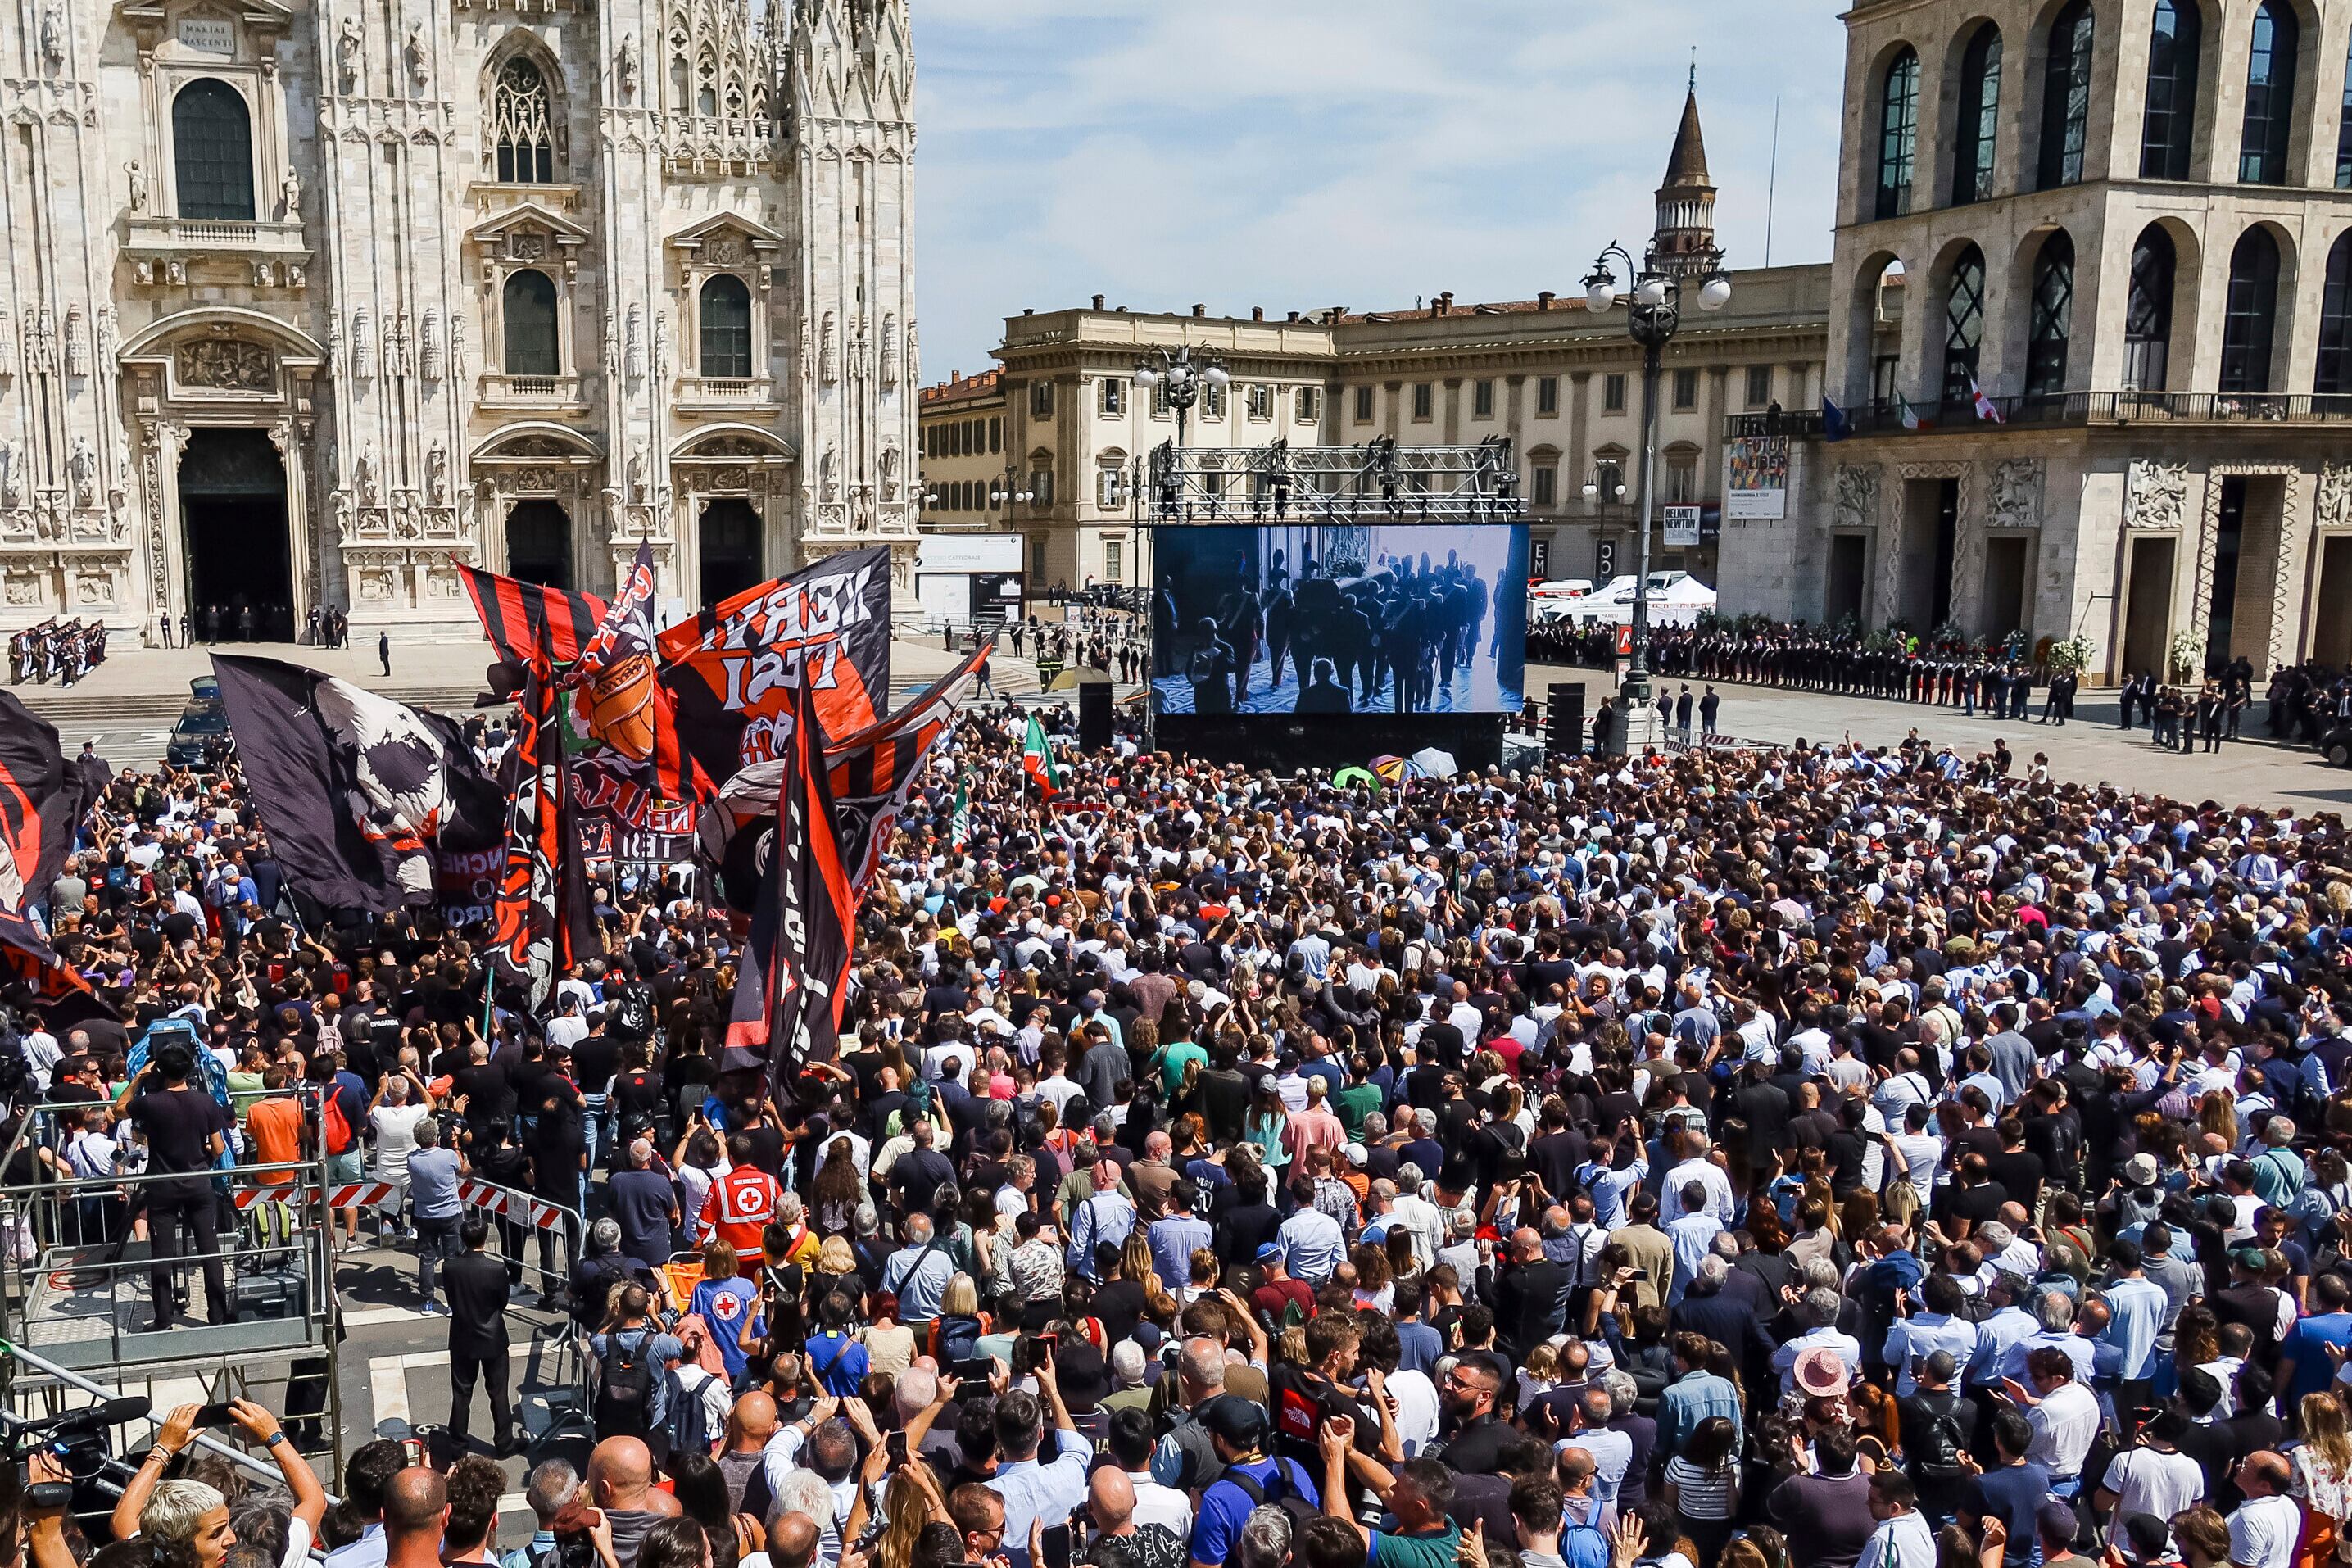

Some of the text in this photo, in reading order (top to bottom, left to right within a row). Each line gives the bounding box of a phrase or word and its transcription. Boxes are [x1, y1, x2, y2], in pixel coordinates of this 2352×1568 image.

[1665, 508, 1693, 519] HELMUT
[1665, 519, 1696, 529] NEWTON
[369, 1019, 399, 1028] OPAGANDA
